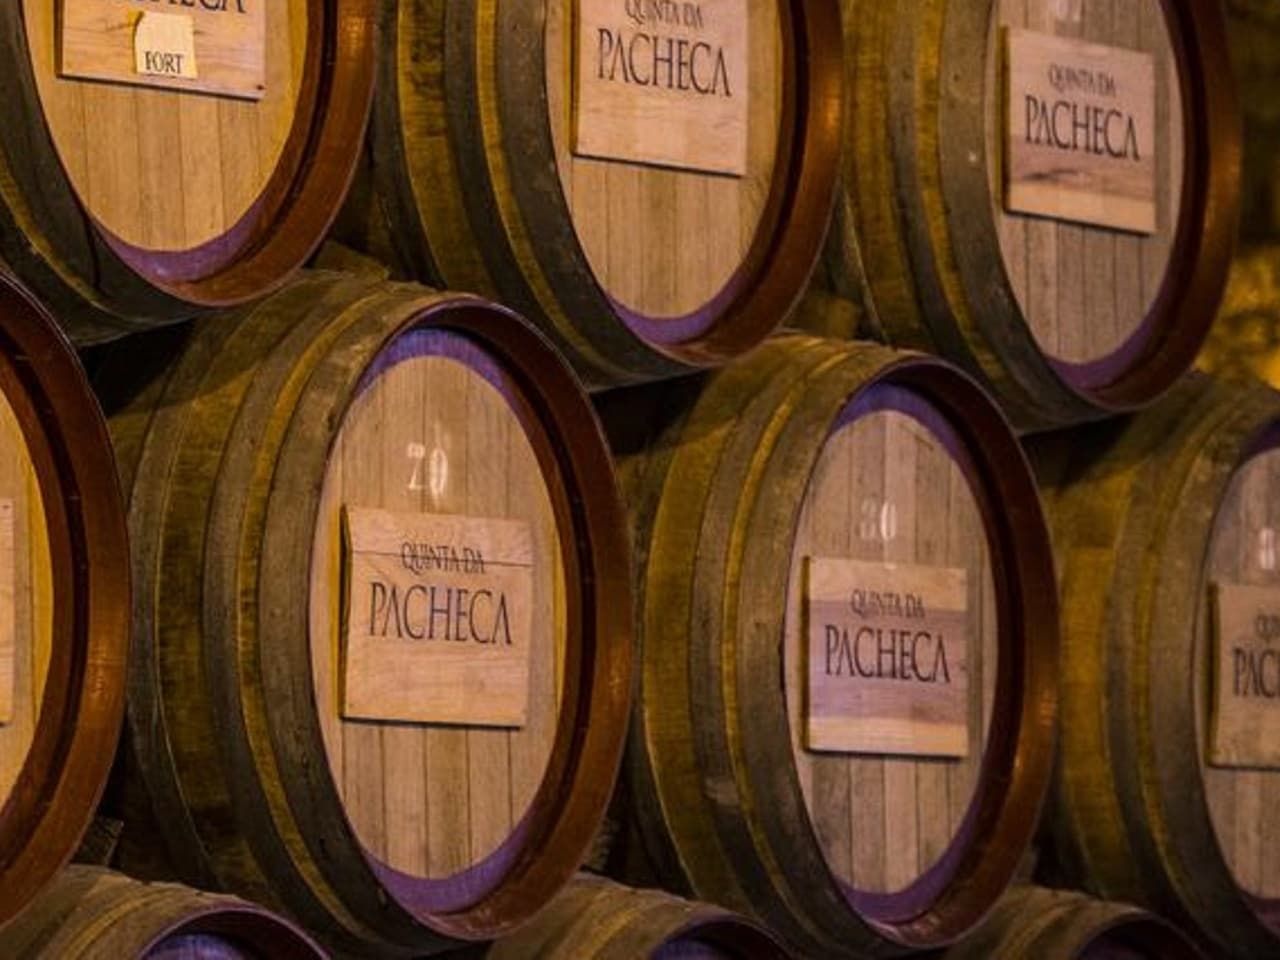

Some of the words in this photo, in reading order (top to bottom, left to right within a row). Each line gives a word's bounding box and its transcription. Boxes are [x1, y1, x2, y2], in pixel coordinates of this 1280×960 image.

[596, 26, 733, 98] PACHECA
[1024, 93, 1141, 162] PACHECA
[400, 540, 460, 576] QUINTA
[463, 546, 486, 575] DA
[369, 581, 513, 646] PACHECA
[824, 624, 952, 684] PACHECA
